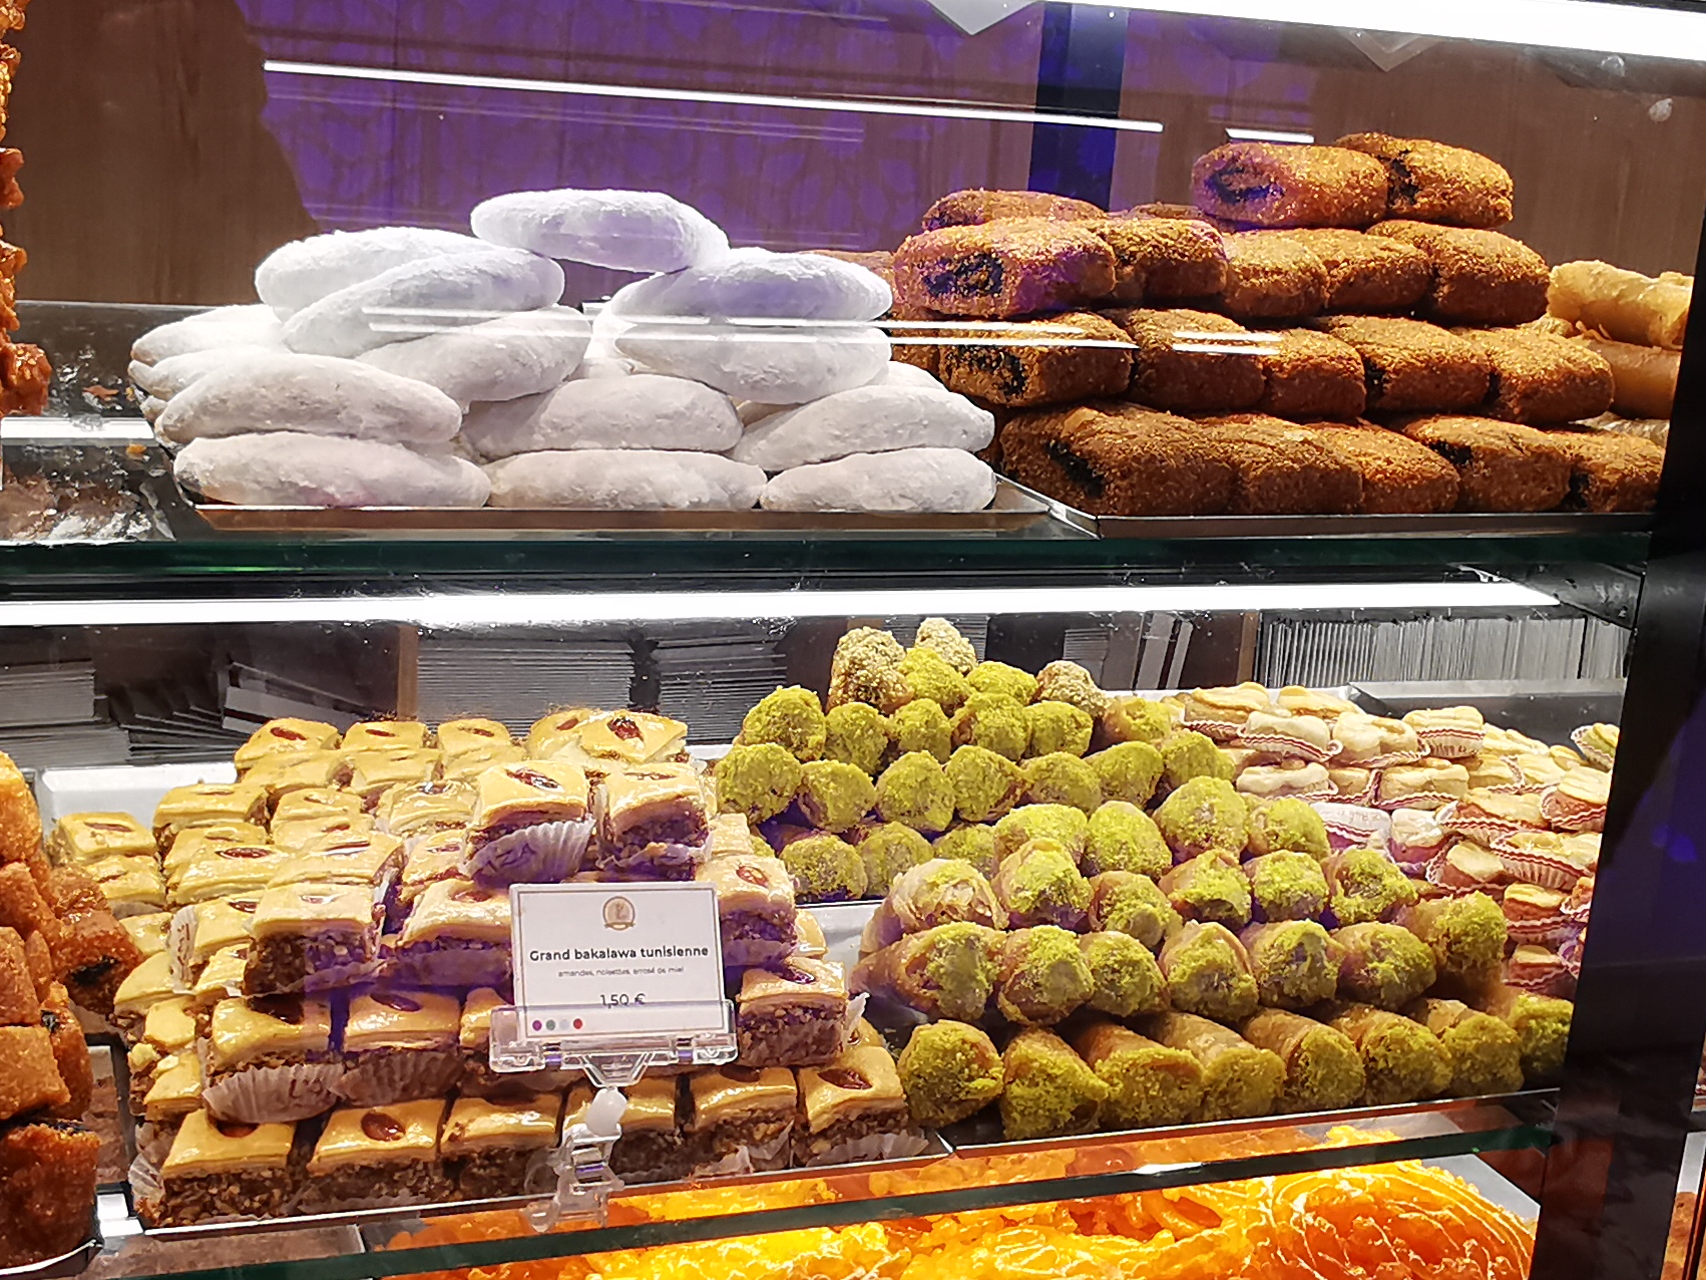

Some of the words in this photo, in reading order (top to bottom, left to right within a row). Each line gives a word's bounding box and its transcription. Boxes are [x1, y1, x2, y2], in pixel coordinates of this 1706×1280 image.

[529, 948, 571, 962] Grand
[574, 946, 638, 961] bakalawa
[640, 944, 710, 959] tunisienne
[599, 993, 630, 1010] 1,50
[633, 992, 647, 1007] €
